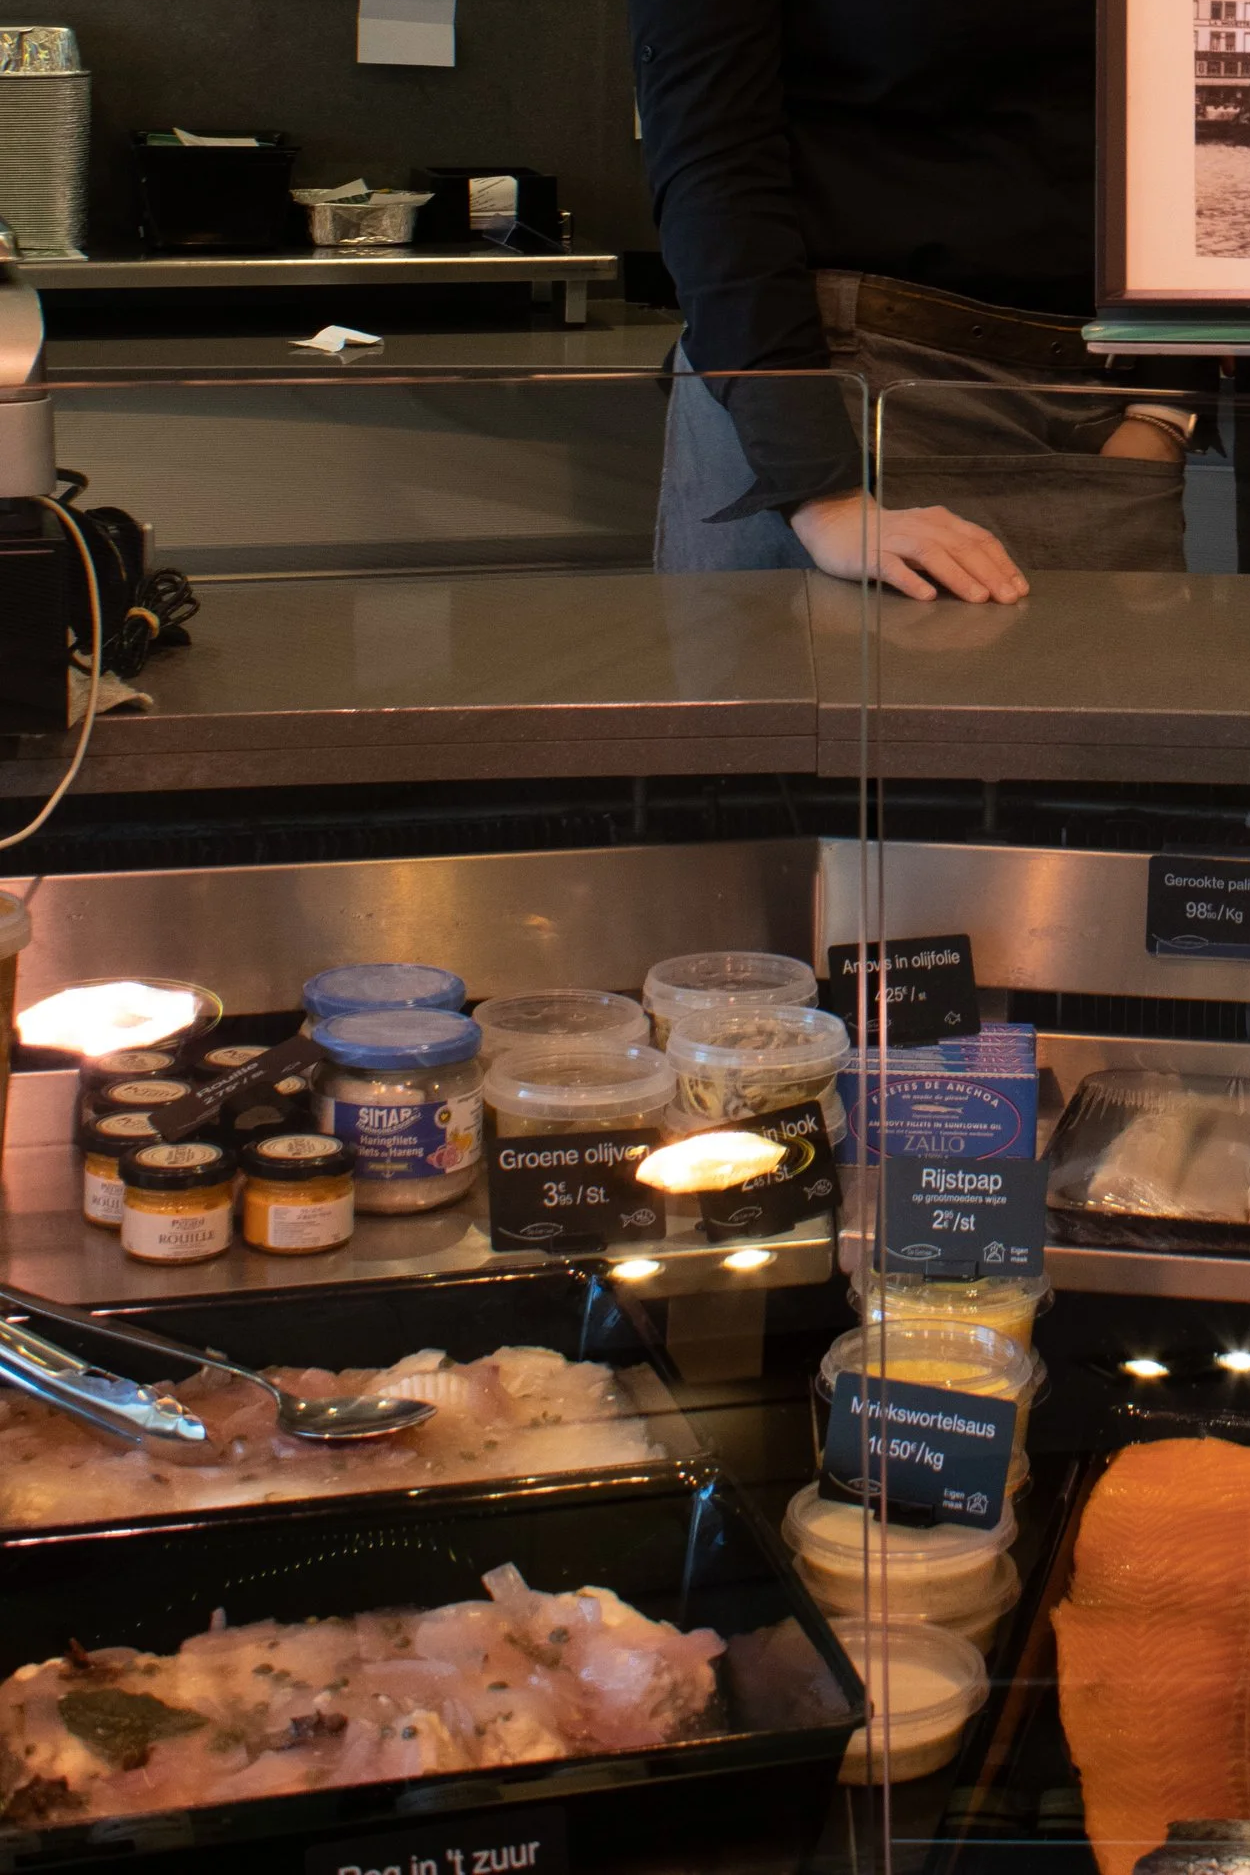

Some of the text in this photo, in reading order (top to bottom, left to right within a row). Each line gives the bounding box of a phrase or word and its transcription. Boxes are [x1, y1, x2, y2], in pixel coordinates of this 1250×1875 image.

[1164, 873, 1225, 890] Gerookte
[895, 954, 908, 969] in
[911, 949, 961, 970] olijfolie
[925, 1081, 940, 1090] DE
[947, 1082, 999, 1108] ANCHOA
[762, 1114, 820, 1142] in look
[360, 1135, 418, 1149] Haringfilets
[903, 1136, 965, 1153] ZALLO
[389, 1146, 424, 1158] Hareng
[499, 1148, 580, 1171] Groene
[922, 1168, 1003, 1194] Rijstpap
[912, 1193, 1008, 1206] op grootmoeders wijze
[158, 1230, 215, 1244] ROUILLE
[1010, 1246, 1029, 1255] Eigen
[943, 1488, 965, 1499] Eigen
[942, 1500, 964, 1510] maak
[446, 1848, 465, 1875] 't
[472, 1841, 541, 1874] zuur
